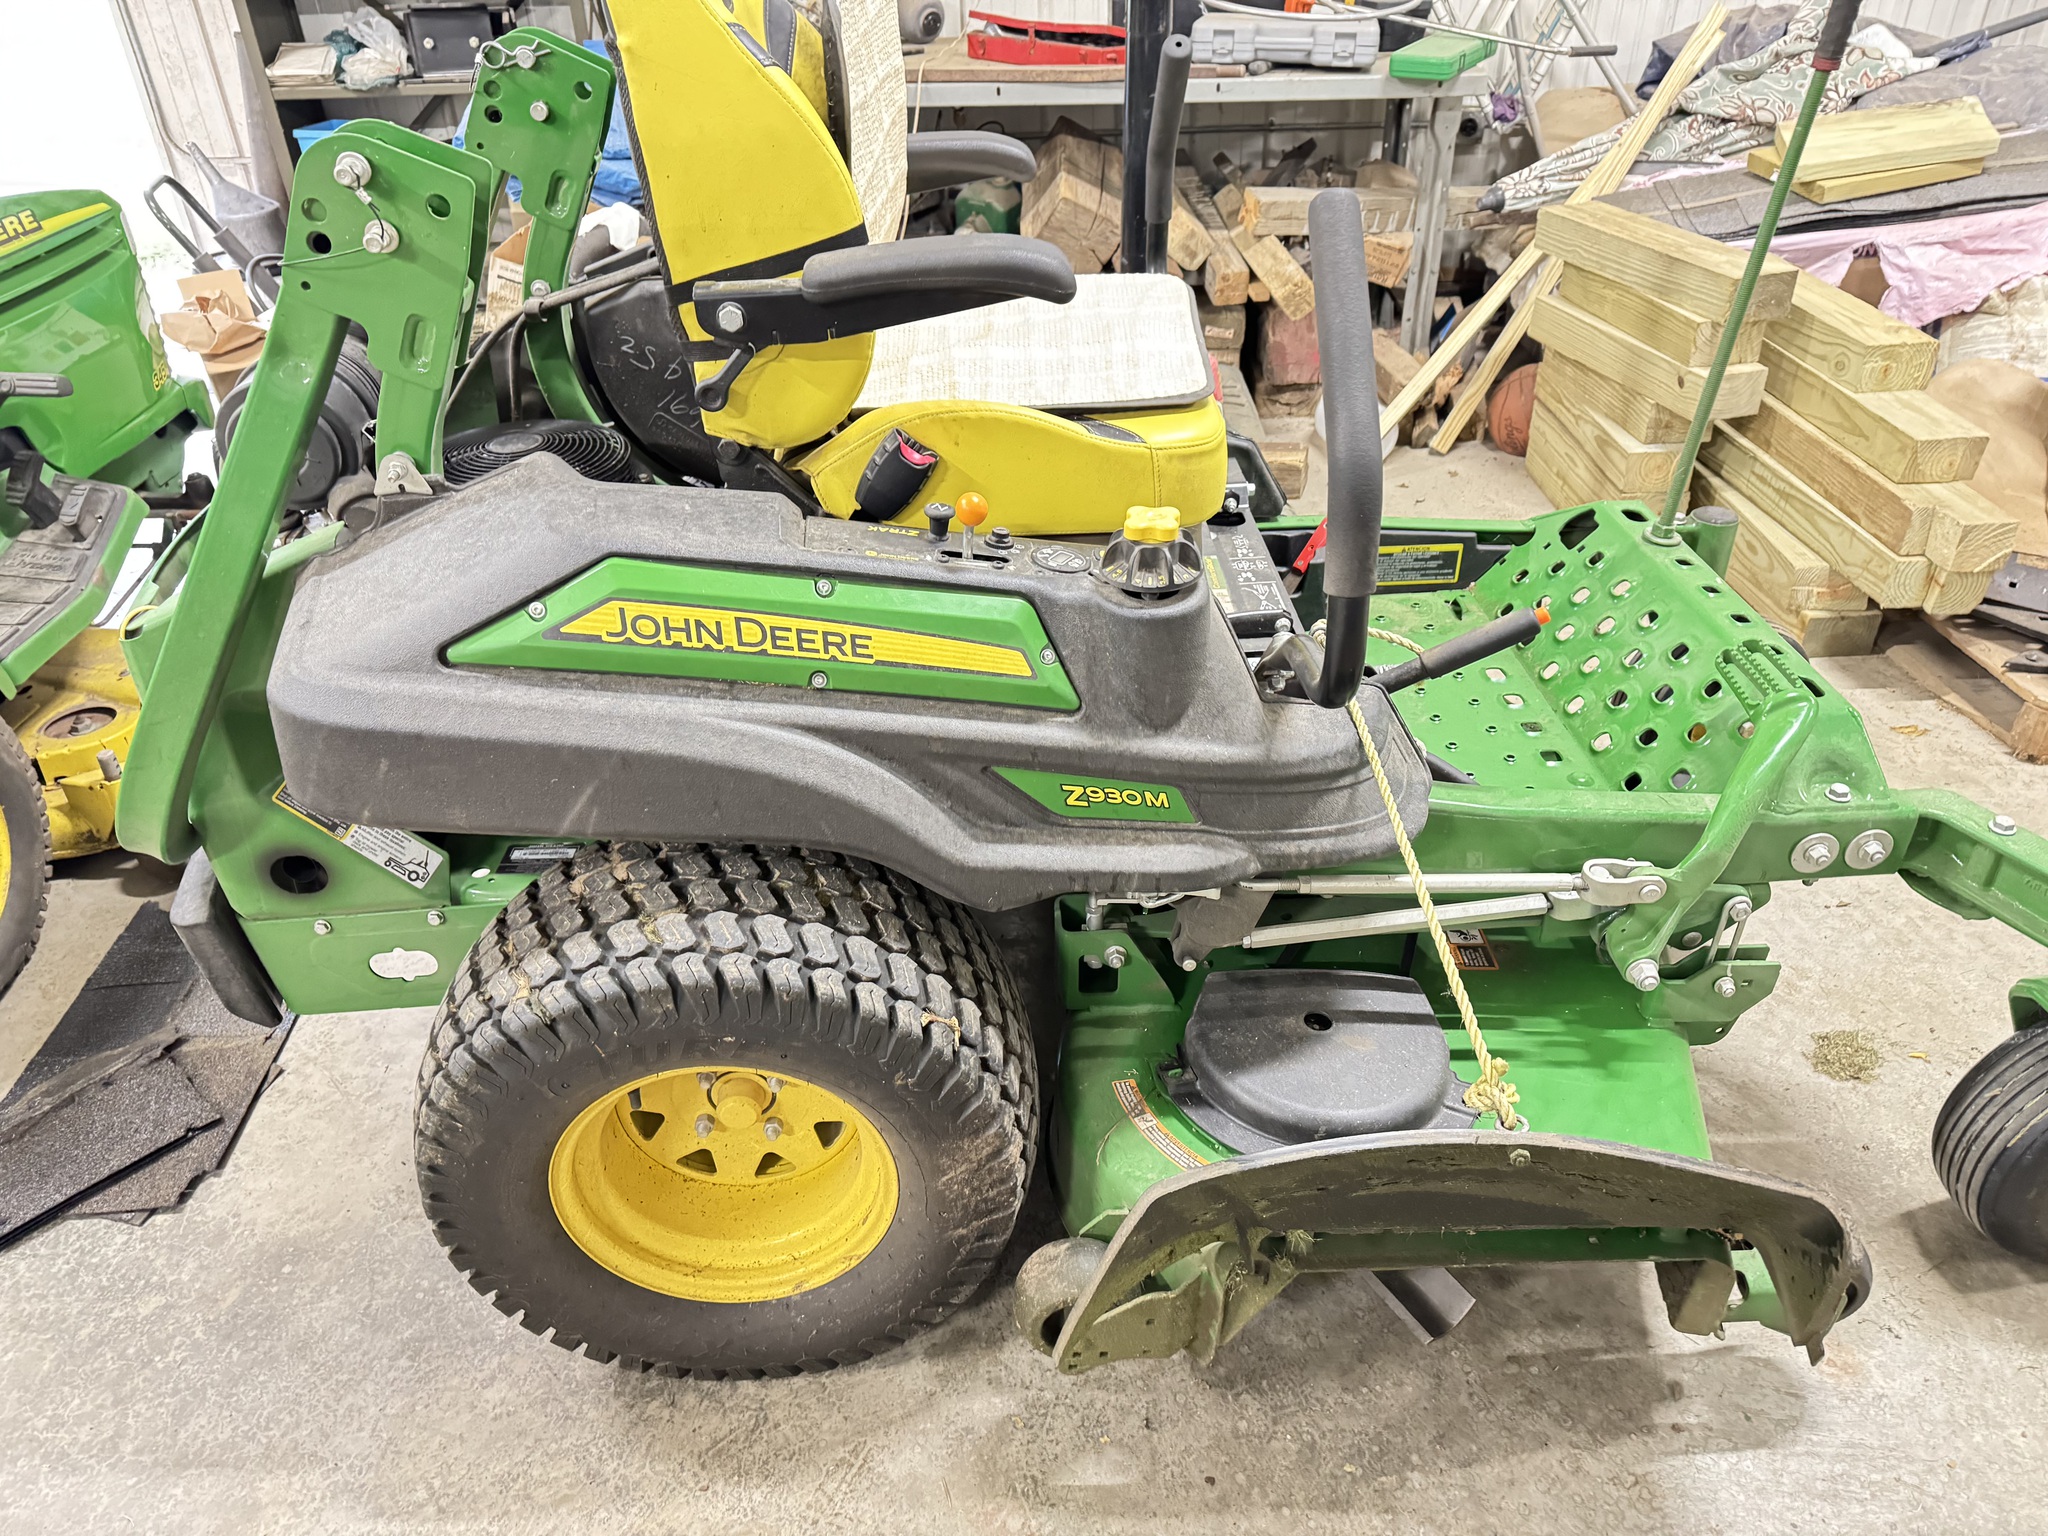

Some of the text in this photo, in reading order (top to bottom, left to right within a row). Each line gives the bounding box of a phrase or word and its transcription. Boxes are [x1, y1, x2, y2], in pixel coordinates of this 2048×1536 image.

[867, 525, 921, 538] ZTRAK
[605, 607, 874, 660] JOHN DEERE
[1060, 784, 1171, 809] Z930M
